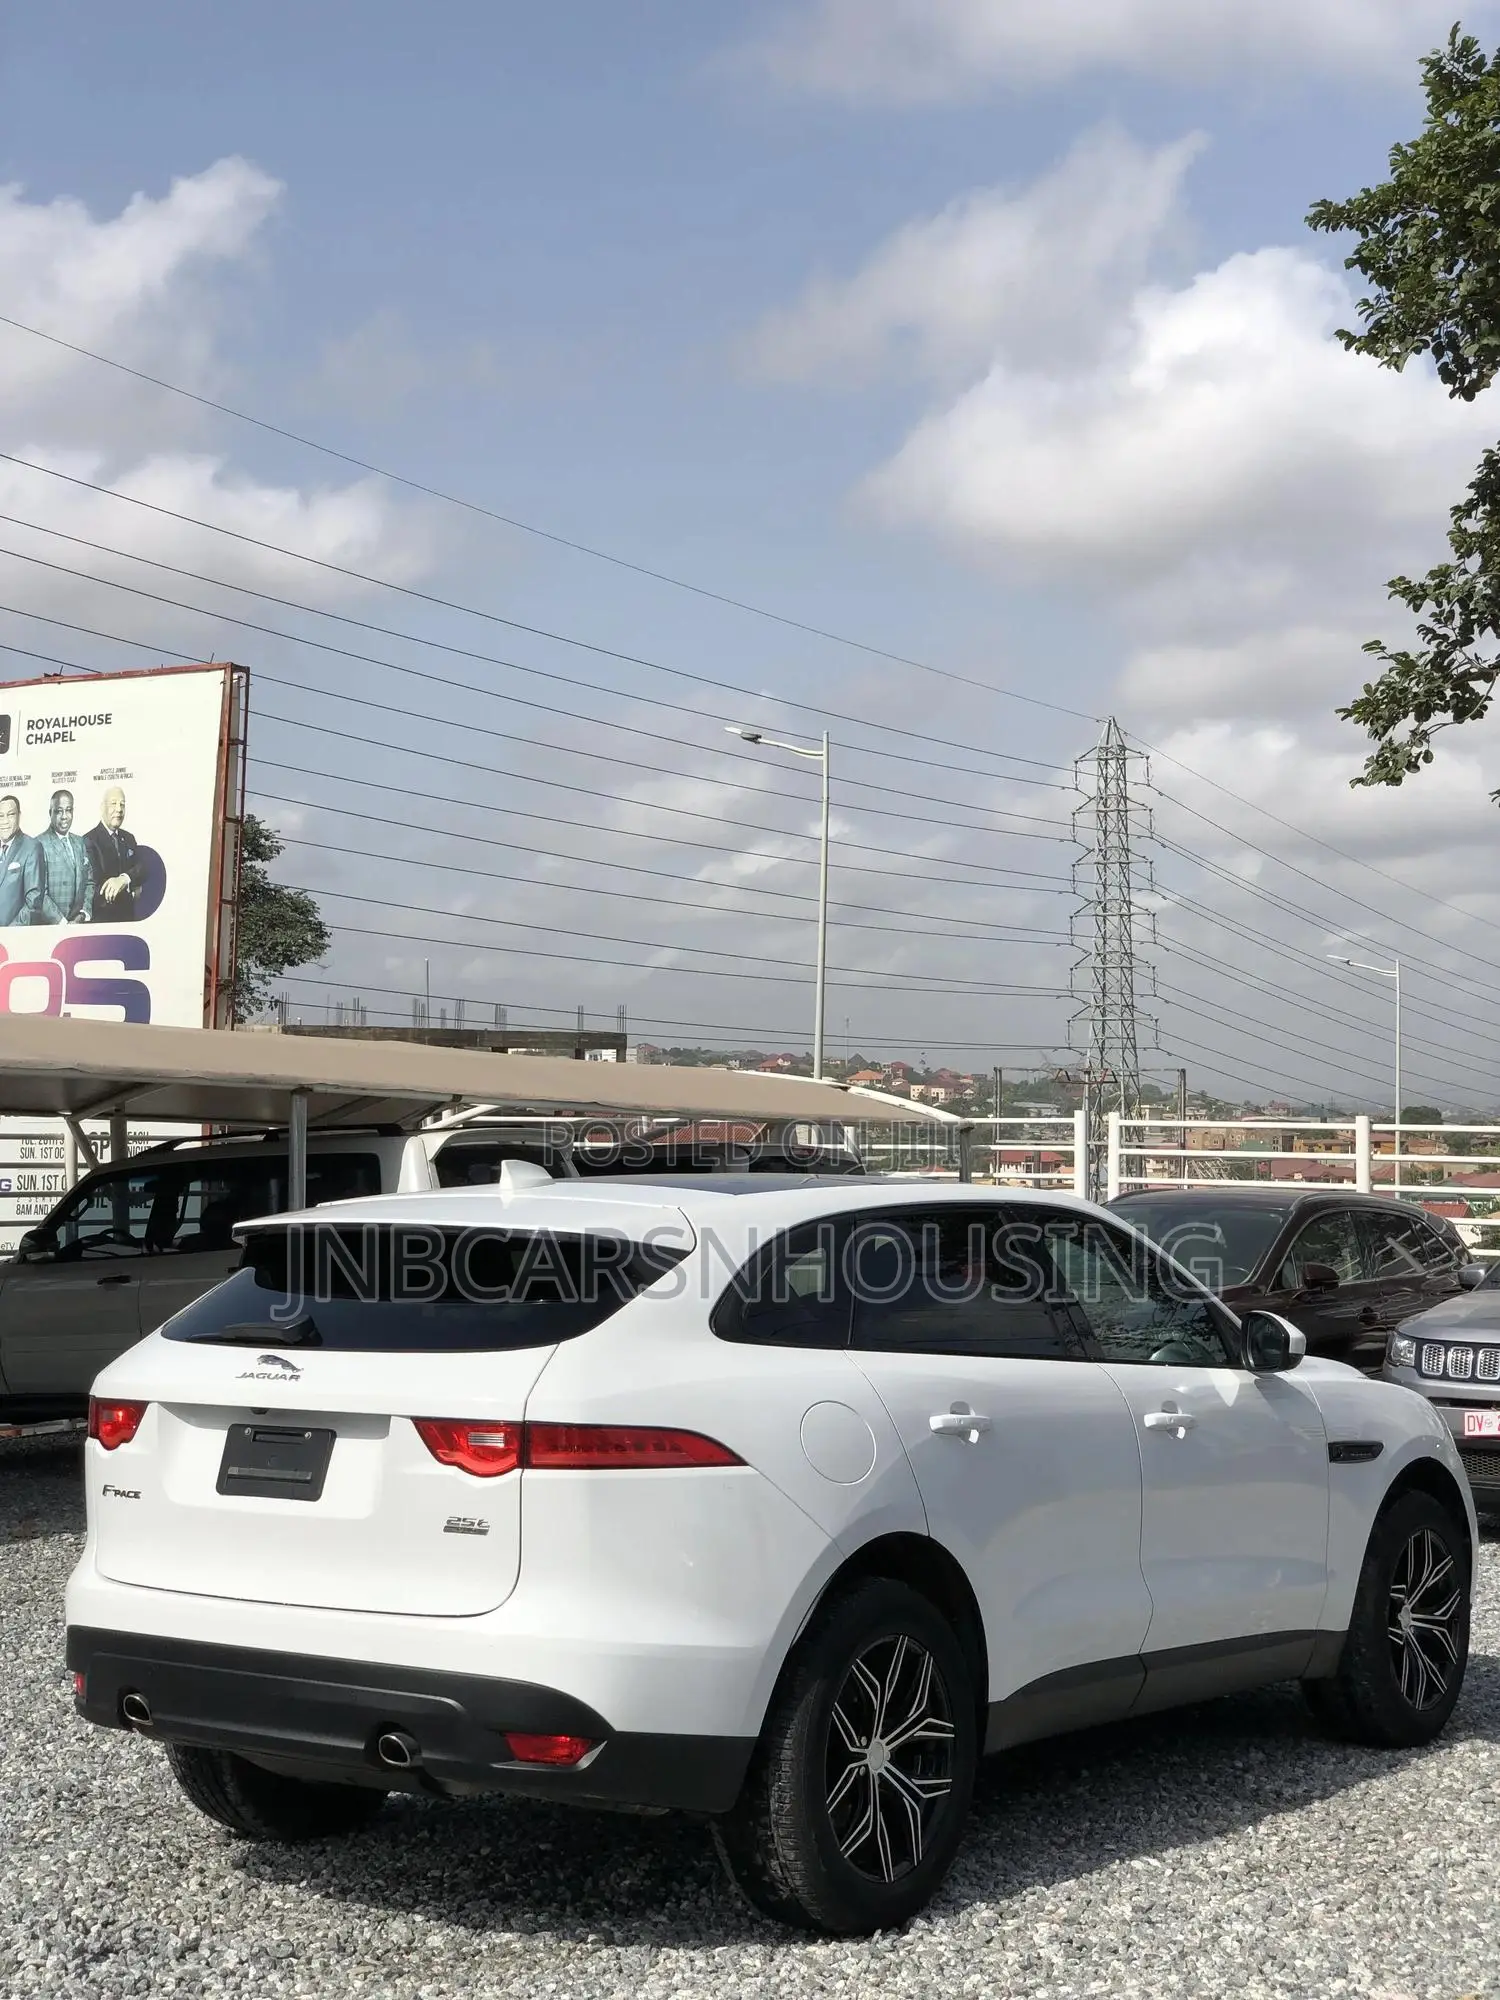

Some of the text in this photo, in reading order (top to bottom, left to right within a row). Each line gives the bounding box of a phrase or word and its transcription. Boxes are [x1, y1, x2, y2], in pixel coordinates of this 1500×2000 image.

[26, 713, 113, 731] ROYALHOUSE
[25, 730, 76, 745] CHAPEL
[54, 1147, 65, 1159] OC
[16, 1204, 32, 1216] 8AM
[235, 1371, 301, 1382] JAGUAR
